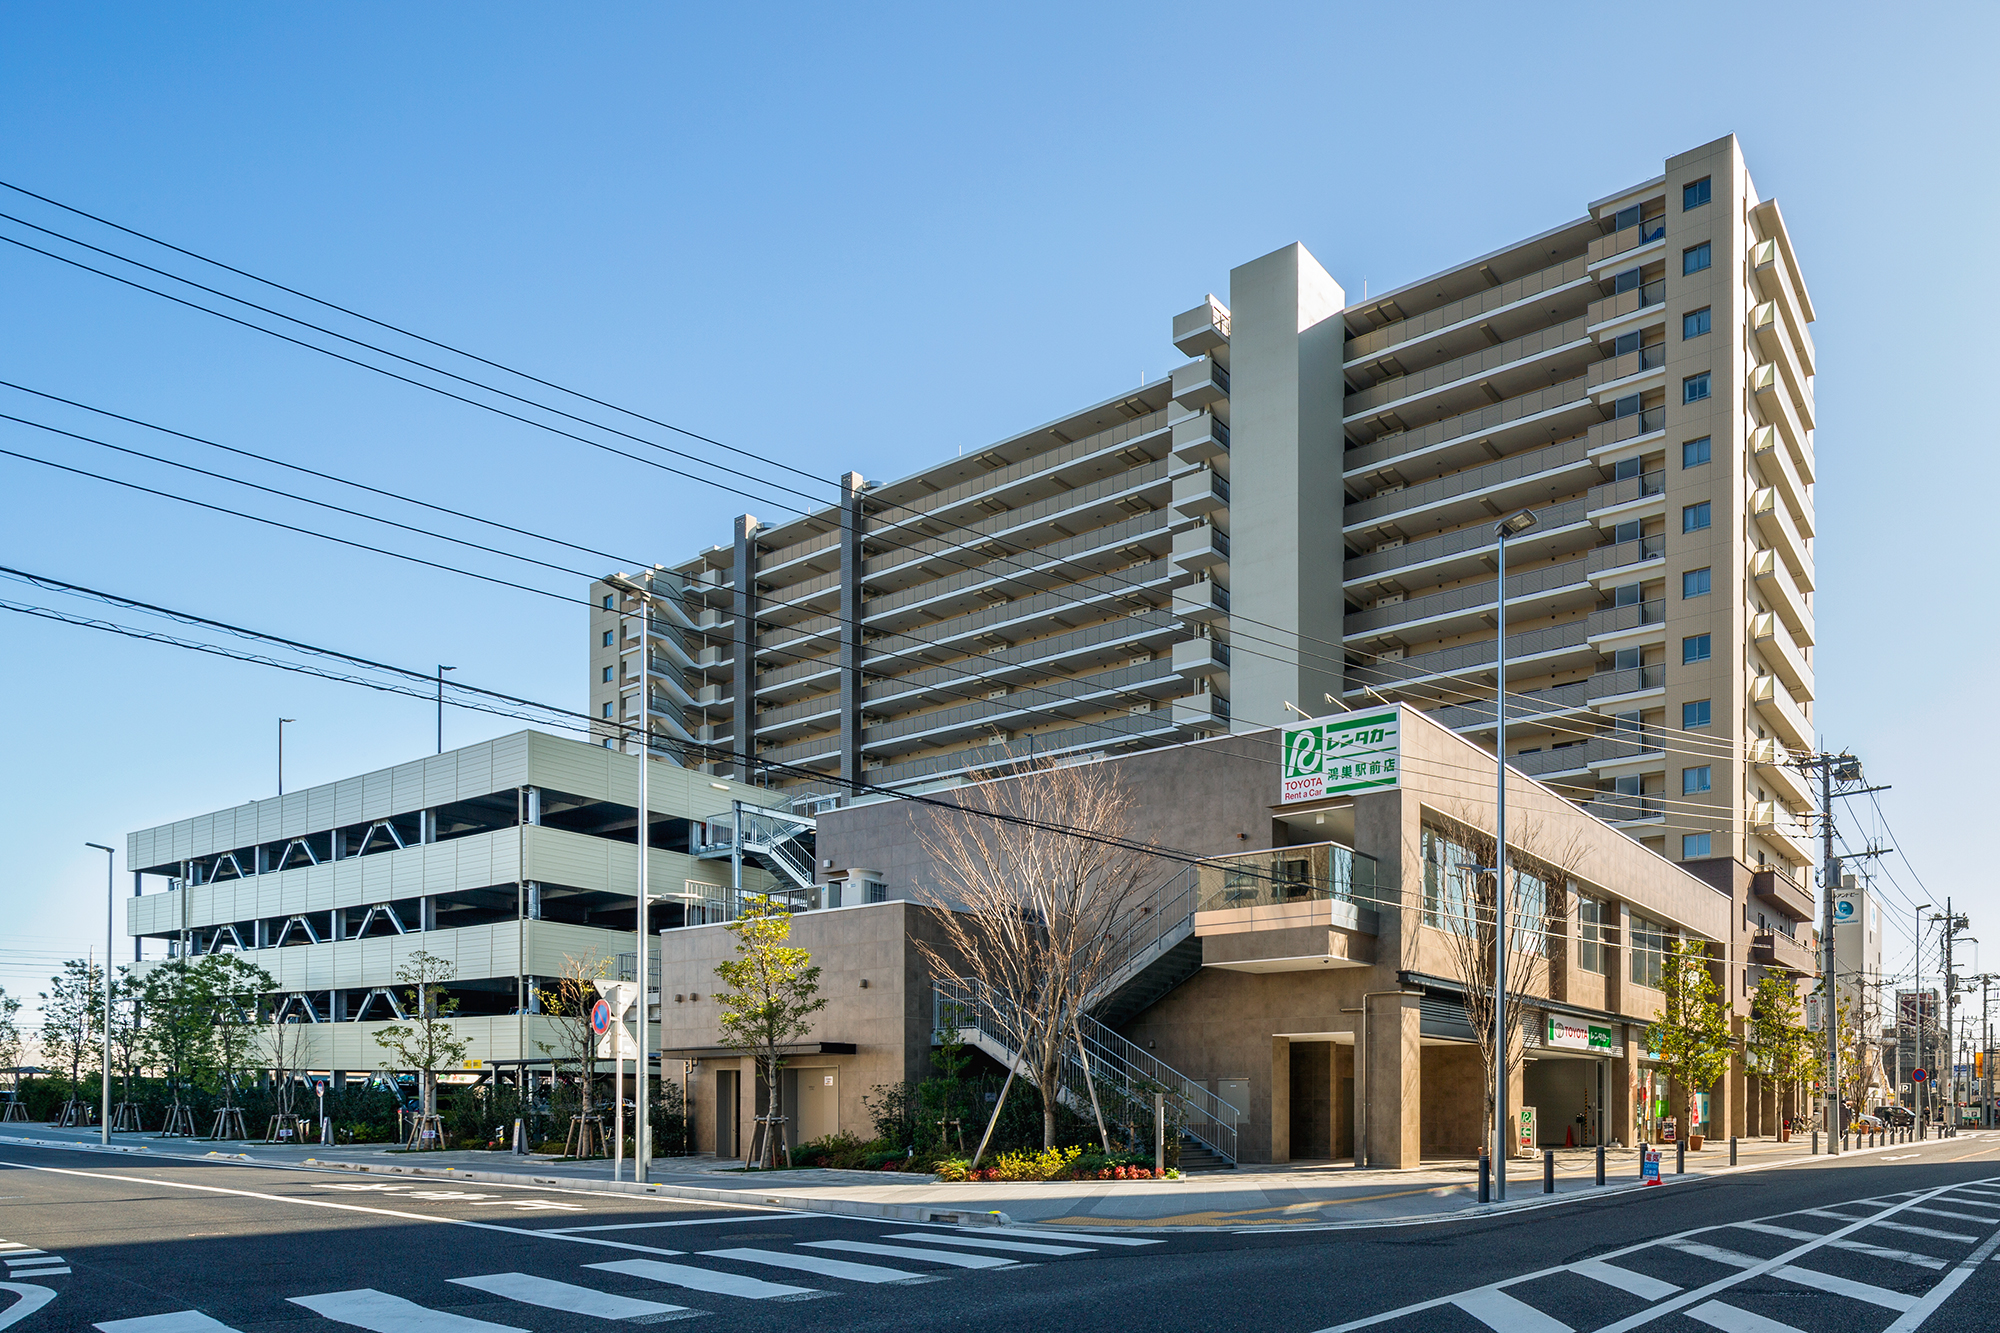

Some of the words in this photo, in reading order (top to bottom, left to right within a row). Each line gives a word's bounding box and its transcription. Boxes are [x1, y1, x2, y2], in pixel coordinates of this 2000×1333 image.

[1326, 729, 1397, 751] レンタカー
[1327, 758, 1396, 781] 鴻巣駅前店
[1285, 777, 1322, 791] TOYOTA
[1285, 792, 1302, 801] Rent
[1308, 788, 1323, 797] Car
[1564, 1026, 1589, 1040] TOYOTA
[1590, 1031, 1610, 1042] レンタカー
[311, 1184, 588, 1211] 止まれ
